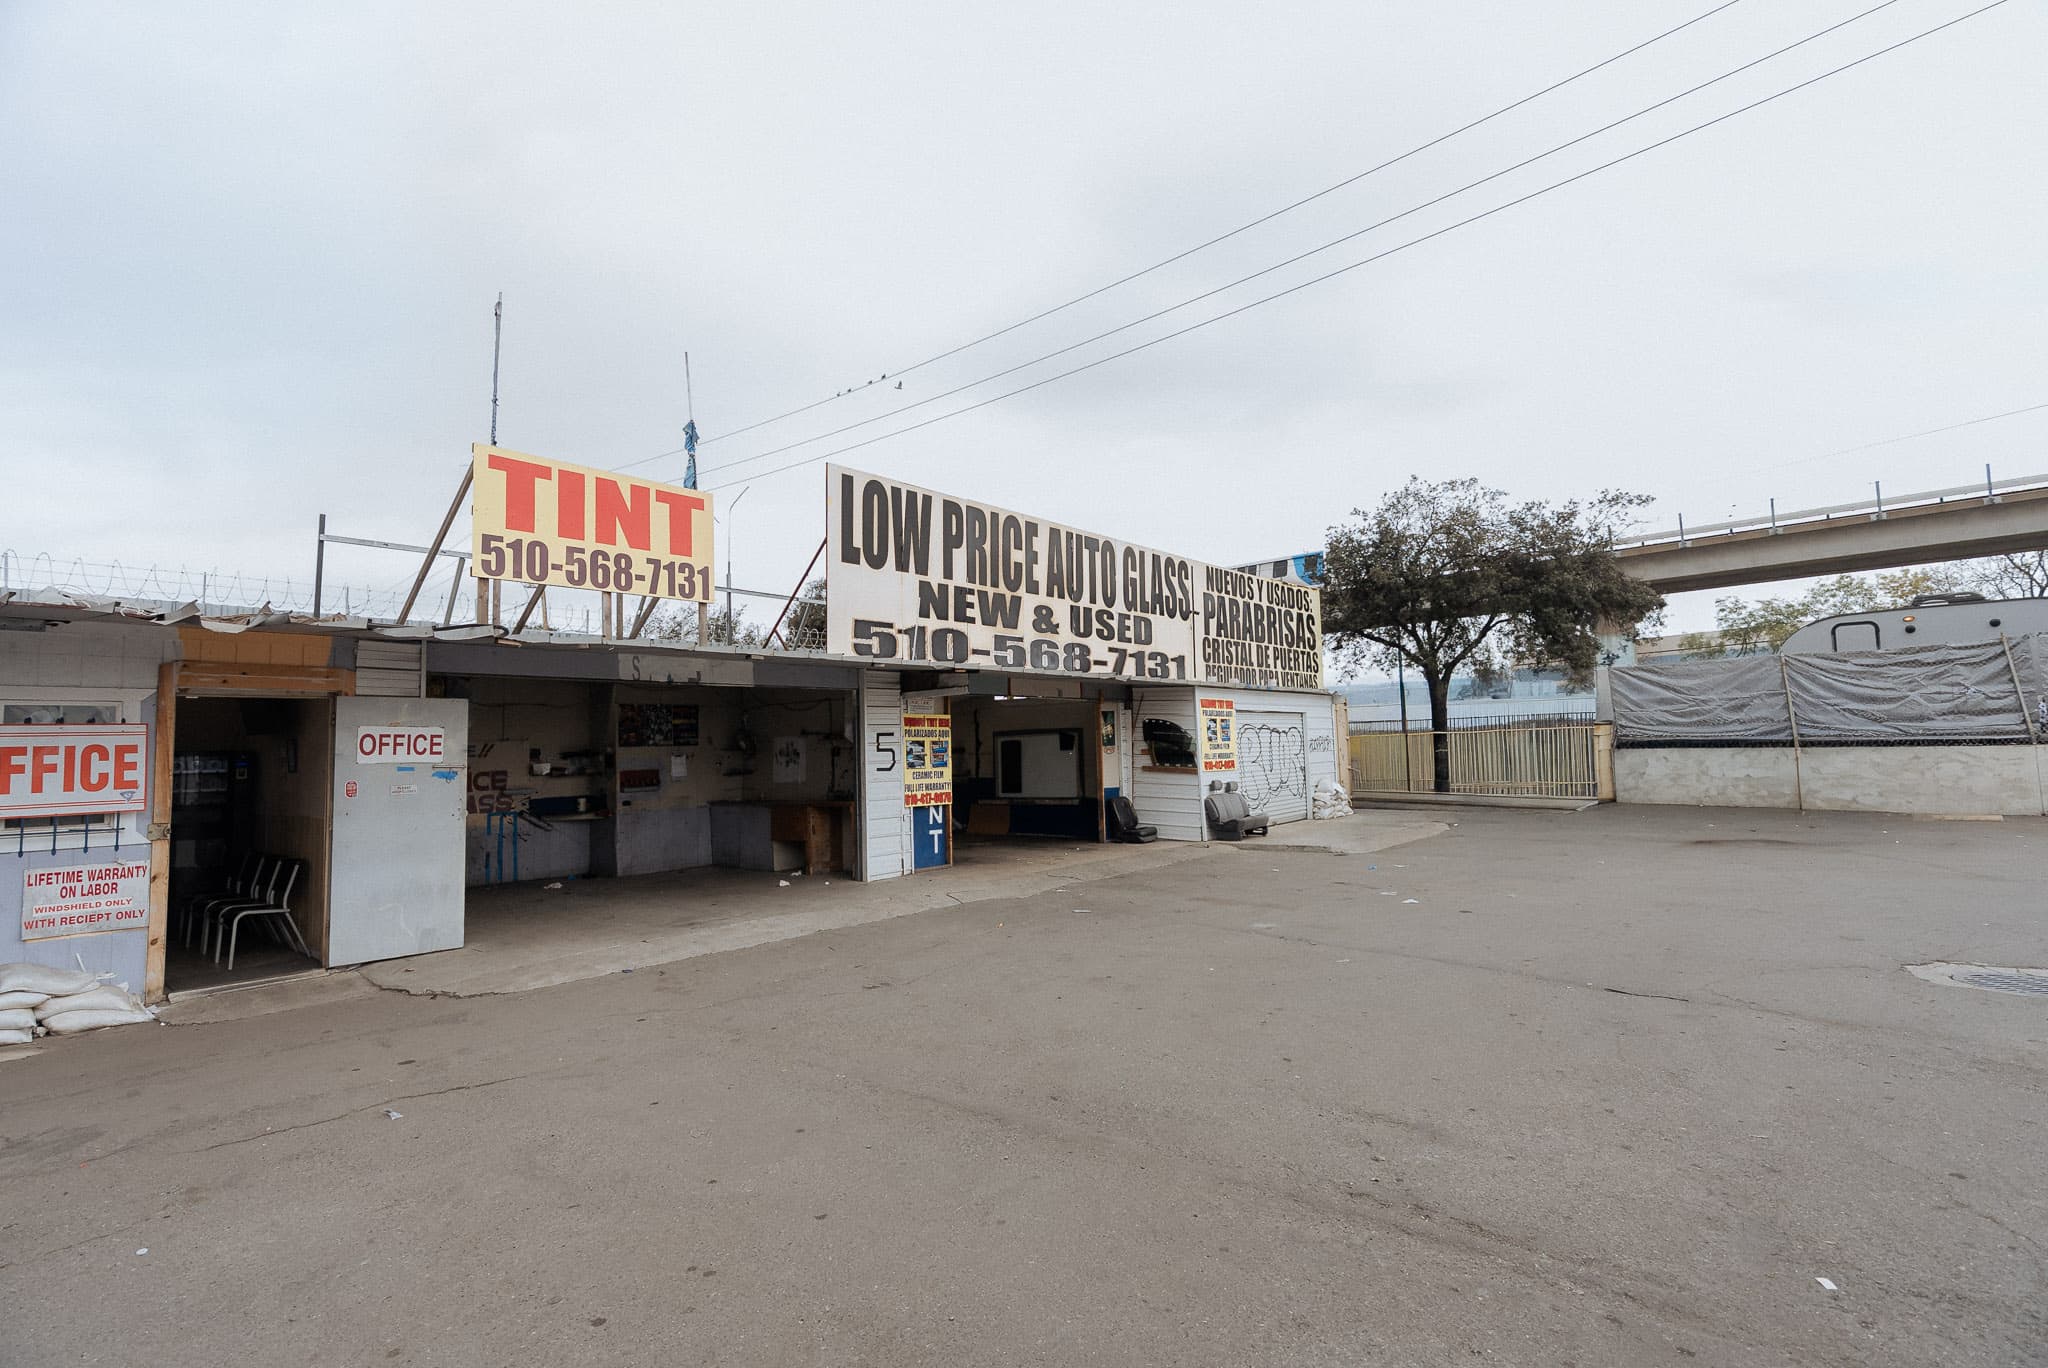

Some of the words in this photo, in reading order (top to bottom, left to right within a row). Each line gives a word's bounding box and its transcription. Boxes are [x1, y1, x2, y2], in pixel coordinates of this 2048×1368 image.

[487, 454, 705, 558] TINT
[841, 473, 933, 577] LOW
[942, 498, 1040, 595] PRICE
[1046, 526, 1117, 609] AUTO
[1122, 546, 1191, 622] GLASS
[481, 533, 710, 601] 510-568-7131
[1206, 565, 1254, 601] NUEVOS
[1256, 578, 1264, 602] Y
[918, 580, 1022, 630] NEW
[1032, 604, 1060, 635] &
[1070, 604, 1153, 646] USED
[1203, 592, 1317, 652] PARABRISAS
[853, 618, 1186, 682] 510-568-7131
[1202, 636, 1254, 668] CRISTAL
[1256, 644, 1271, 669] DE
[1272, 646, 1319, 674] PUERTAS
[1280, 671, 1319, 690] VENTANAS
[359, 733, 443, 756] OFFICE
[876, 732, 897, 772] 5
[27, 870, 84, 888] LIFETIME
[87, 865, 148, 882] WARRANTY
[60, 885, 77, 899] ON
[80, 882, 119, 897] LABOR
[24, 918, 56, 930] WITH
[60, 912, 112, 926] RECIEPT
[115, 909, 145, 920] ONLY
[34, 901, 102, 914] WINDSHIELD
[105, 898, 133, 907] ONLY
